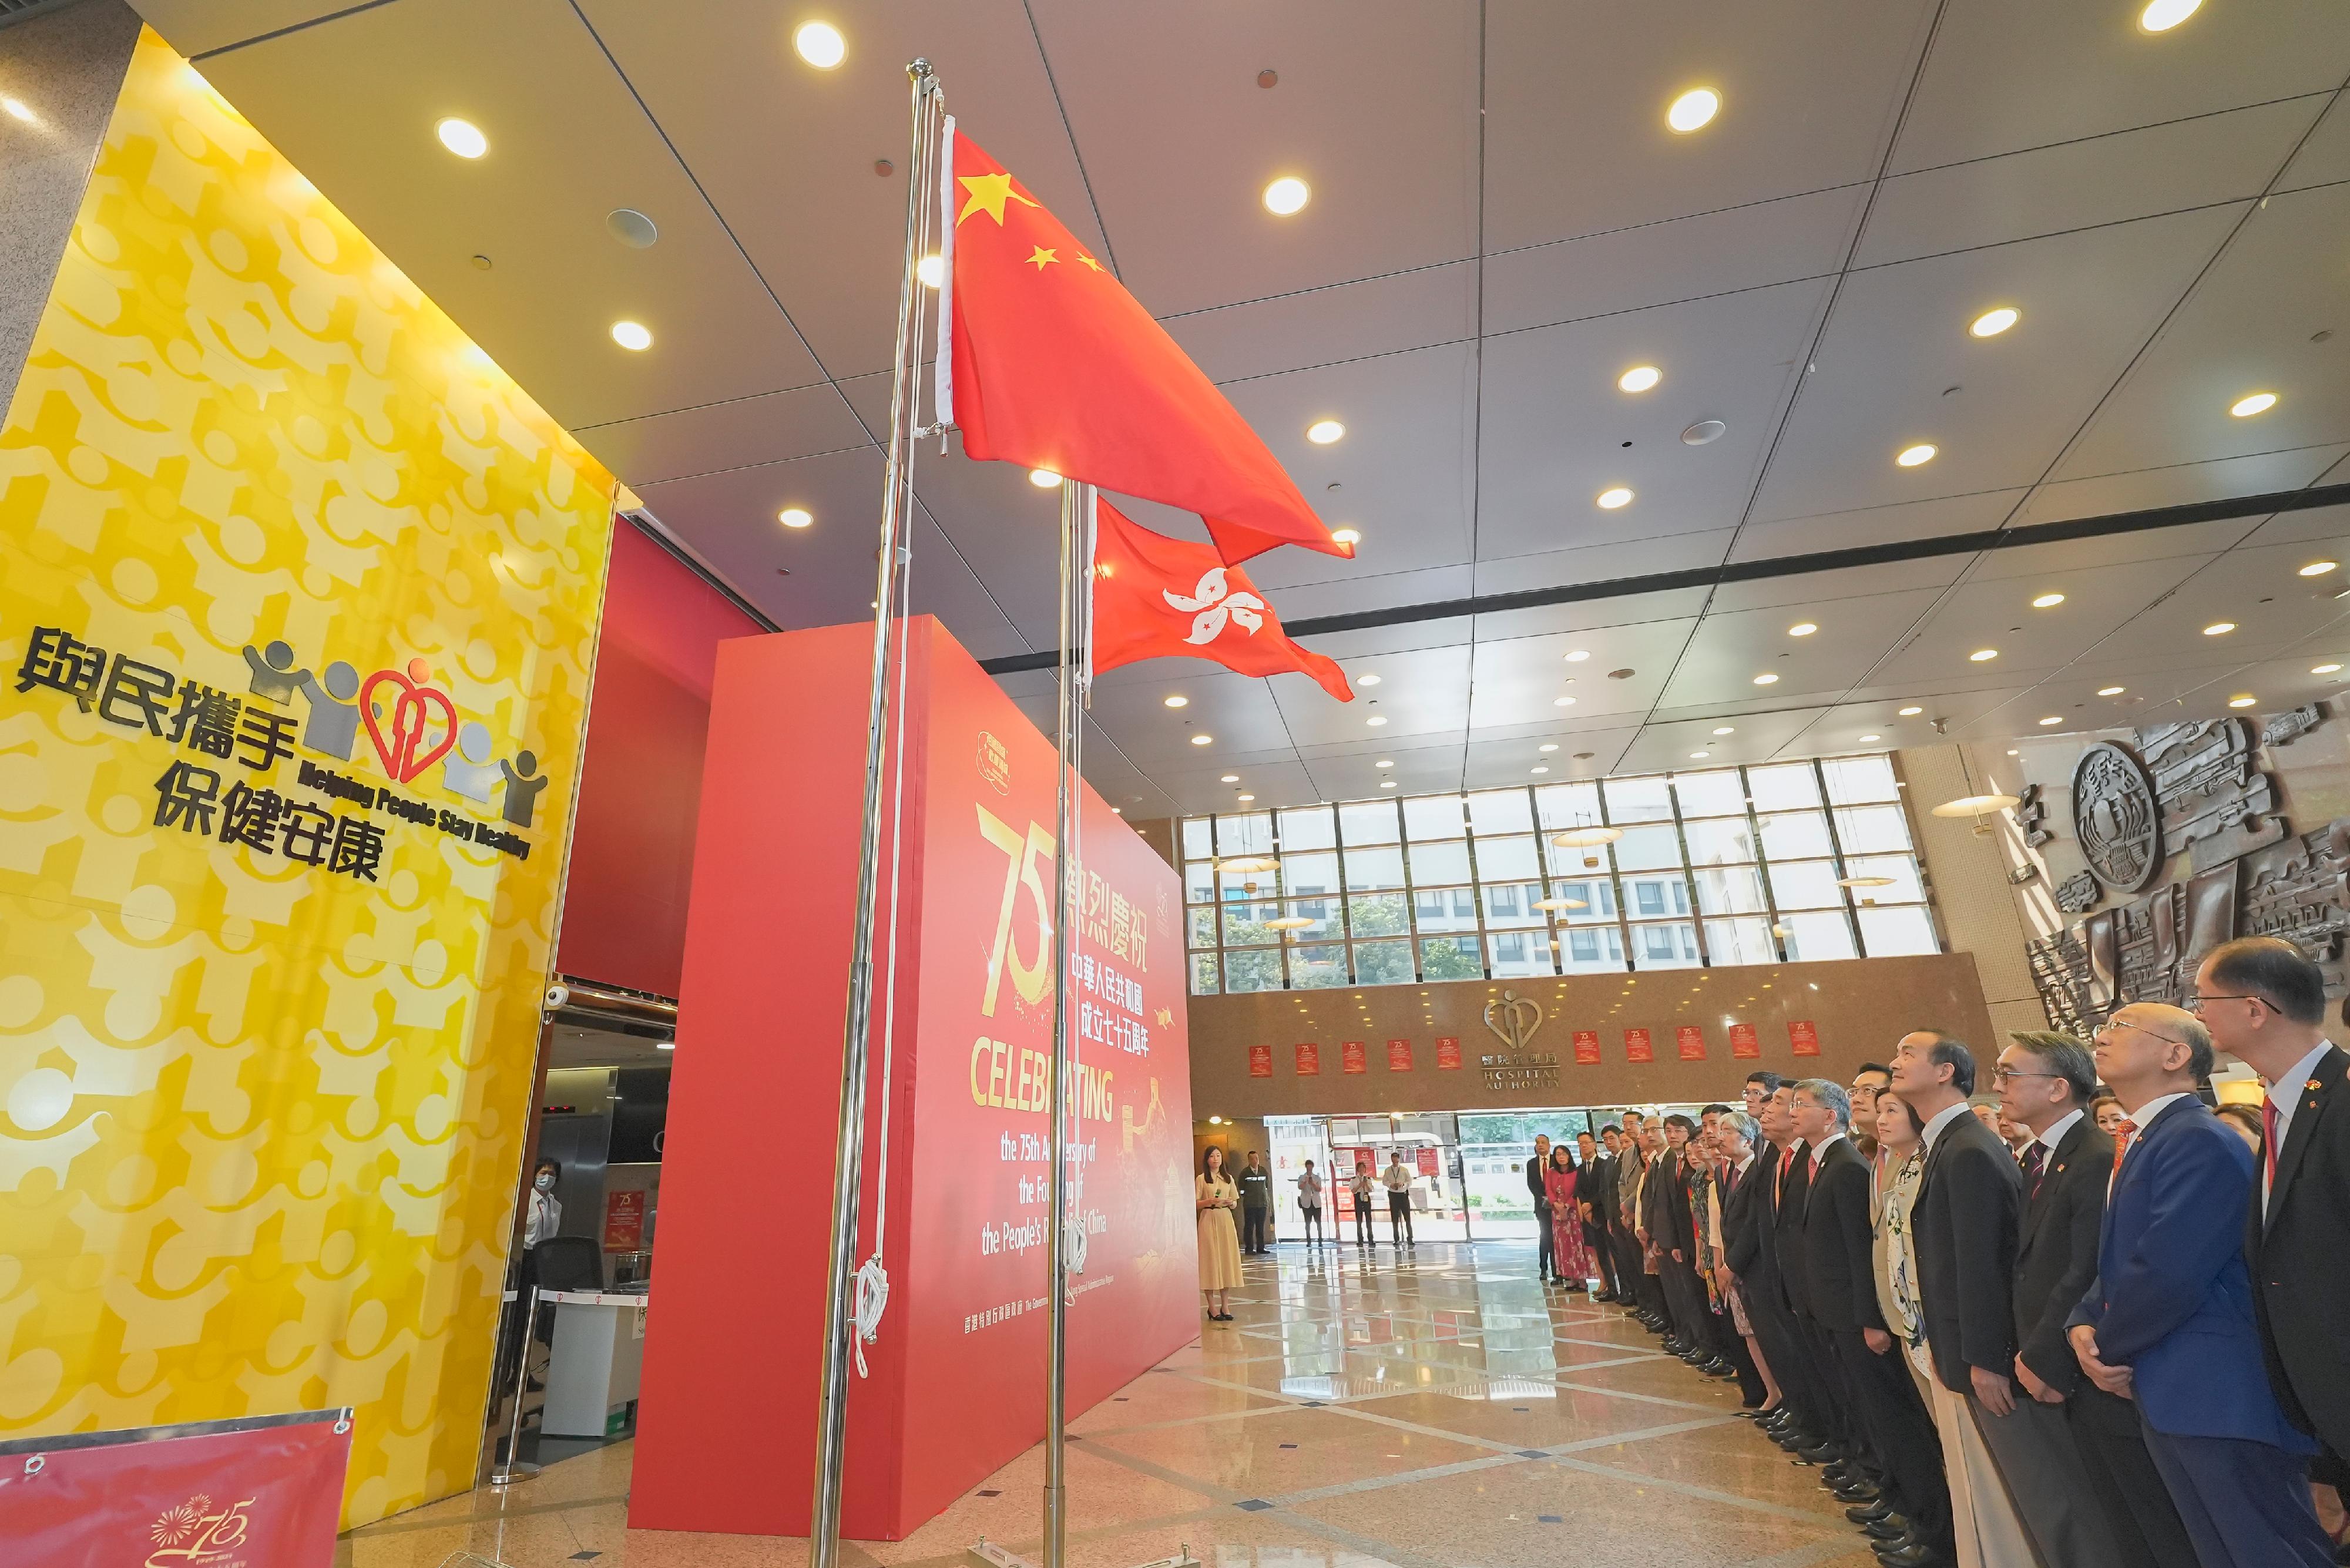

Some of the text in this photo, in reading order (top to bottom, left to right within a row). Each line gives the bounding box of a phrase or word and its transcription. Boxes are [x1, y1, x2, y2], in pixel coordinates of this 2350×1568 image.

[15, 626, 298, 772] 與民攜手
[154, 760, 385, 882] 保健安康
[297, 760, 531, 860] Helping People Stay Healthy
[975, 801, 1056, 1018] 75
[1072, 952, 1143, 1017] 中華人民共和國
[1081, 1000, 1150, 1057] 成立七十五周年
[1484, 1069, 1559, 1080] HOSPITAL
[1486, 1079, 1560, 1090] AUTHORITY
[1001, 1130, 1016, 1161] the
[1020, 1133, 1039, 1161] 75th
[1088, 1137, 1096, 1162] of
[620, 1193, 632, 1206] 75
[1019, 1174, 1034, 1204] the
[982, 1221, 999, 1256] the
[1003, 1217, 1041, 1256] People's
[1088, 1208, 1106, 1235] China
[964, 1300, 1023, 1334] 香港特別行政區政府
